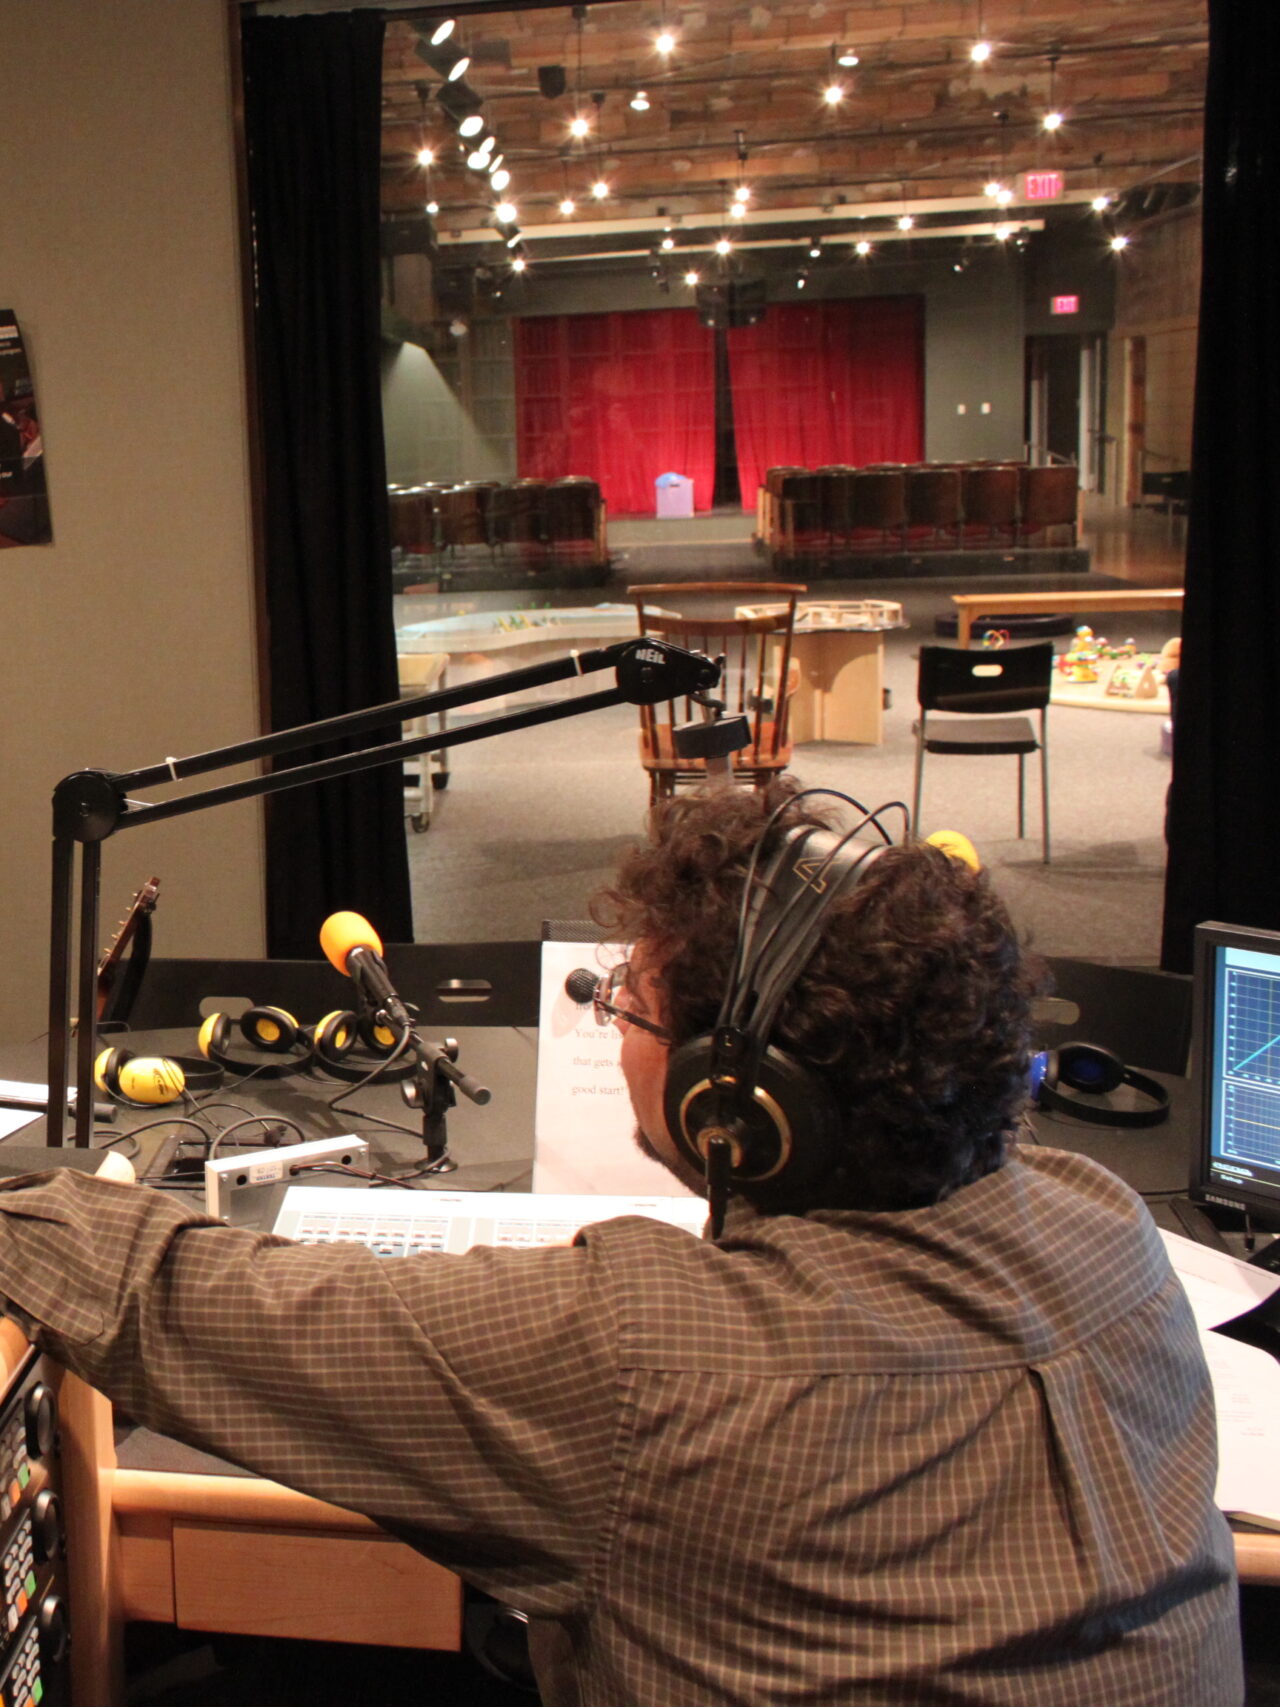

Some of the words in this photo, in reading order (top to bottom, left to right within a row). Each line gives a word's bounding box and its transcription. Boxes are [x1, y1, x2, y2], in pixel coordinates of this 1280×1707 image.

[1027, 174, 1058, 198] EXIT
[1056, 297, 1076, 313] EXIT
[576, 1029, 609, 1039] You're
[573, 1056, 592, 1067] that
[594, 1057, 614, 1069] gets
[571, 1085, 597, 1097] good
[1205, 1194, 1246, 1211] SAMSUNG
